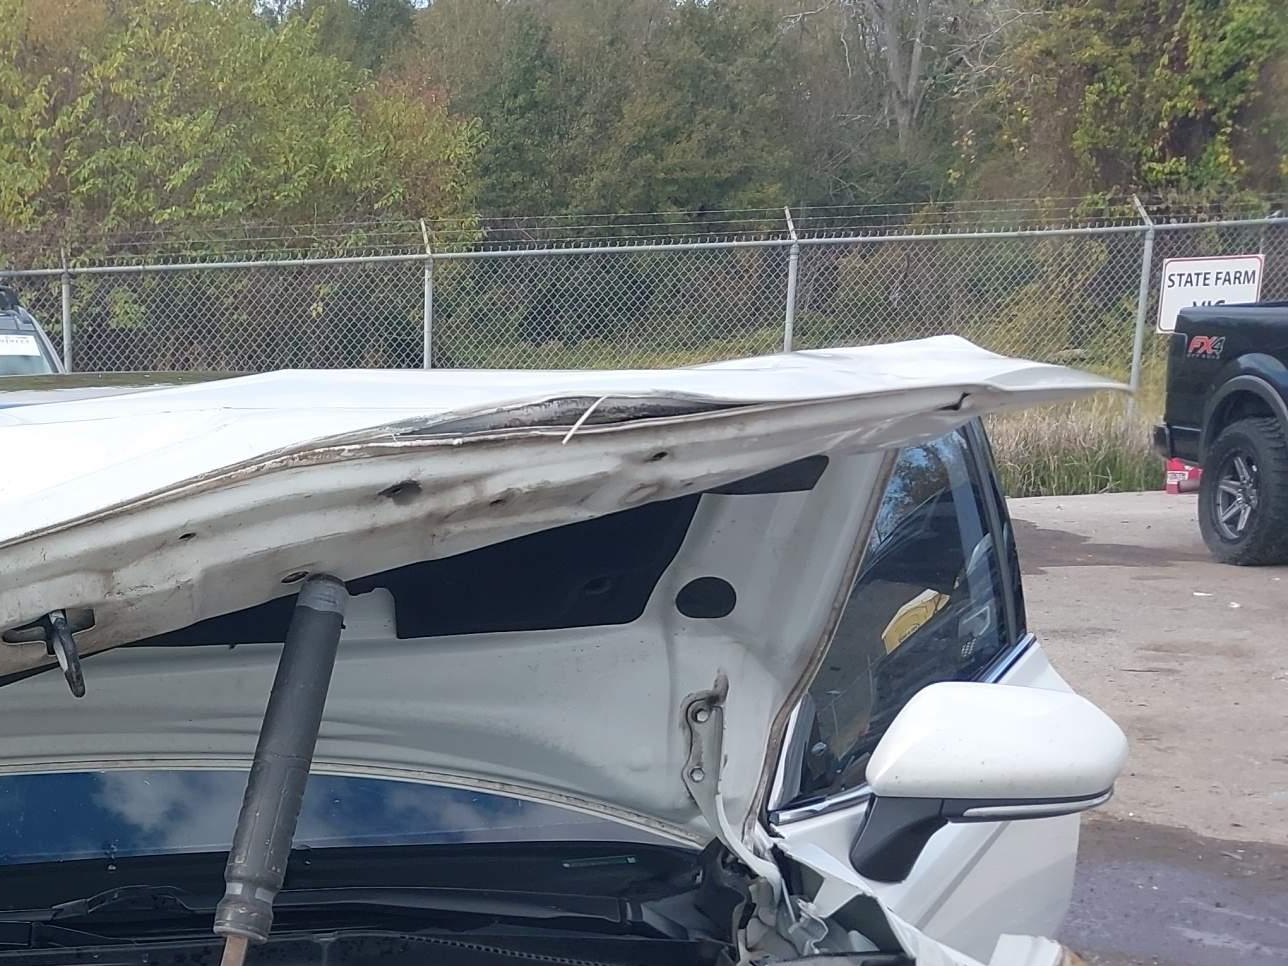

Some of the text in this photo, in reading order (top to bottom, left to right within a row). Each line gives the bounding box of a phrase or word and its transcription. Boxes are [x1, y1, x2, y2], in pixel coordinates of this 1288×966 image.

[1167, 269, 1256, 288] STATE FARM
[1188, 335, 1226, 354] FX4
